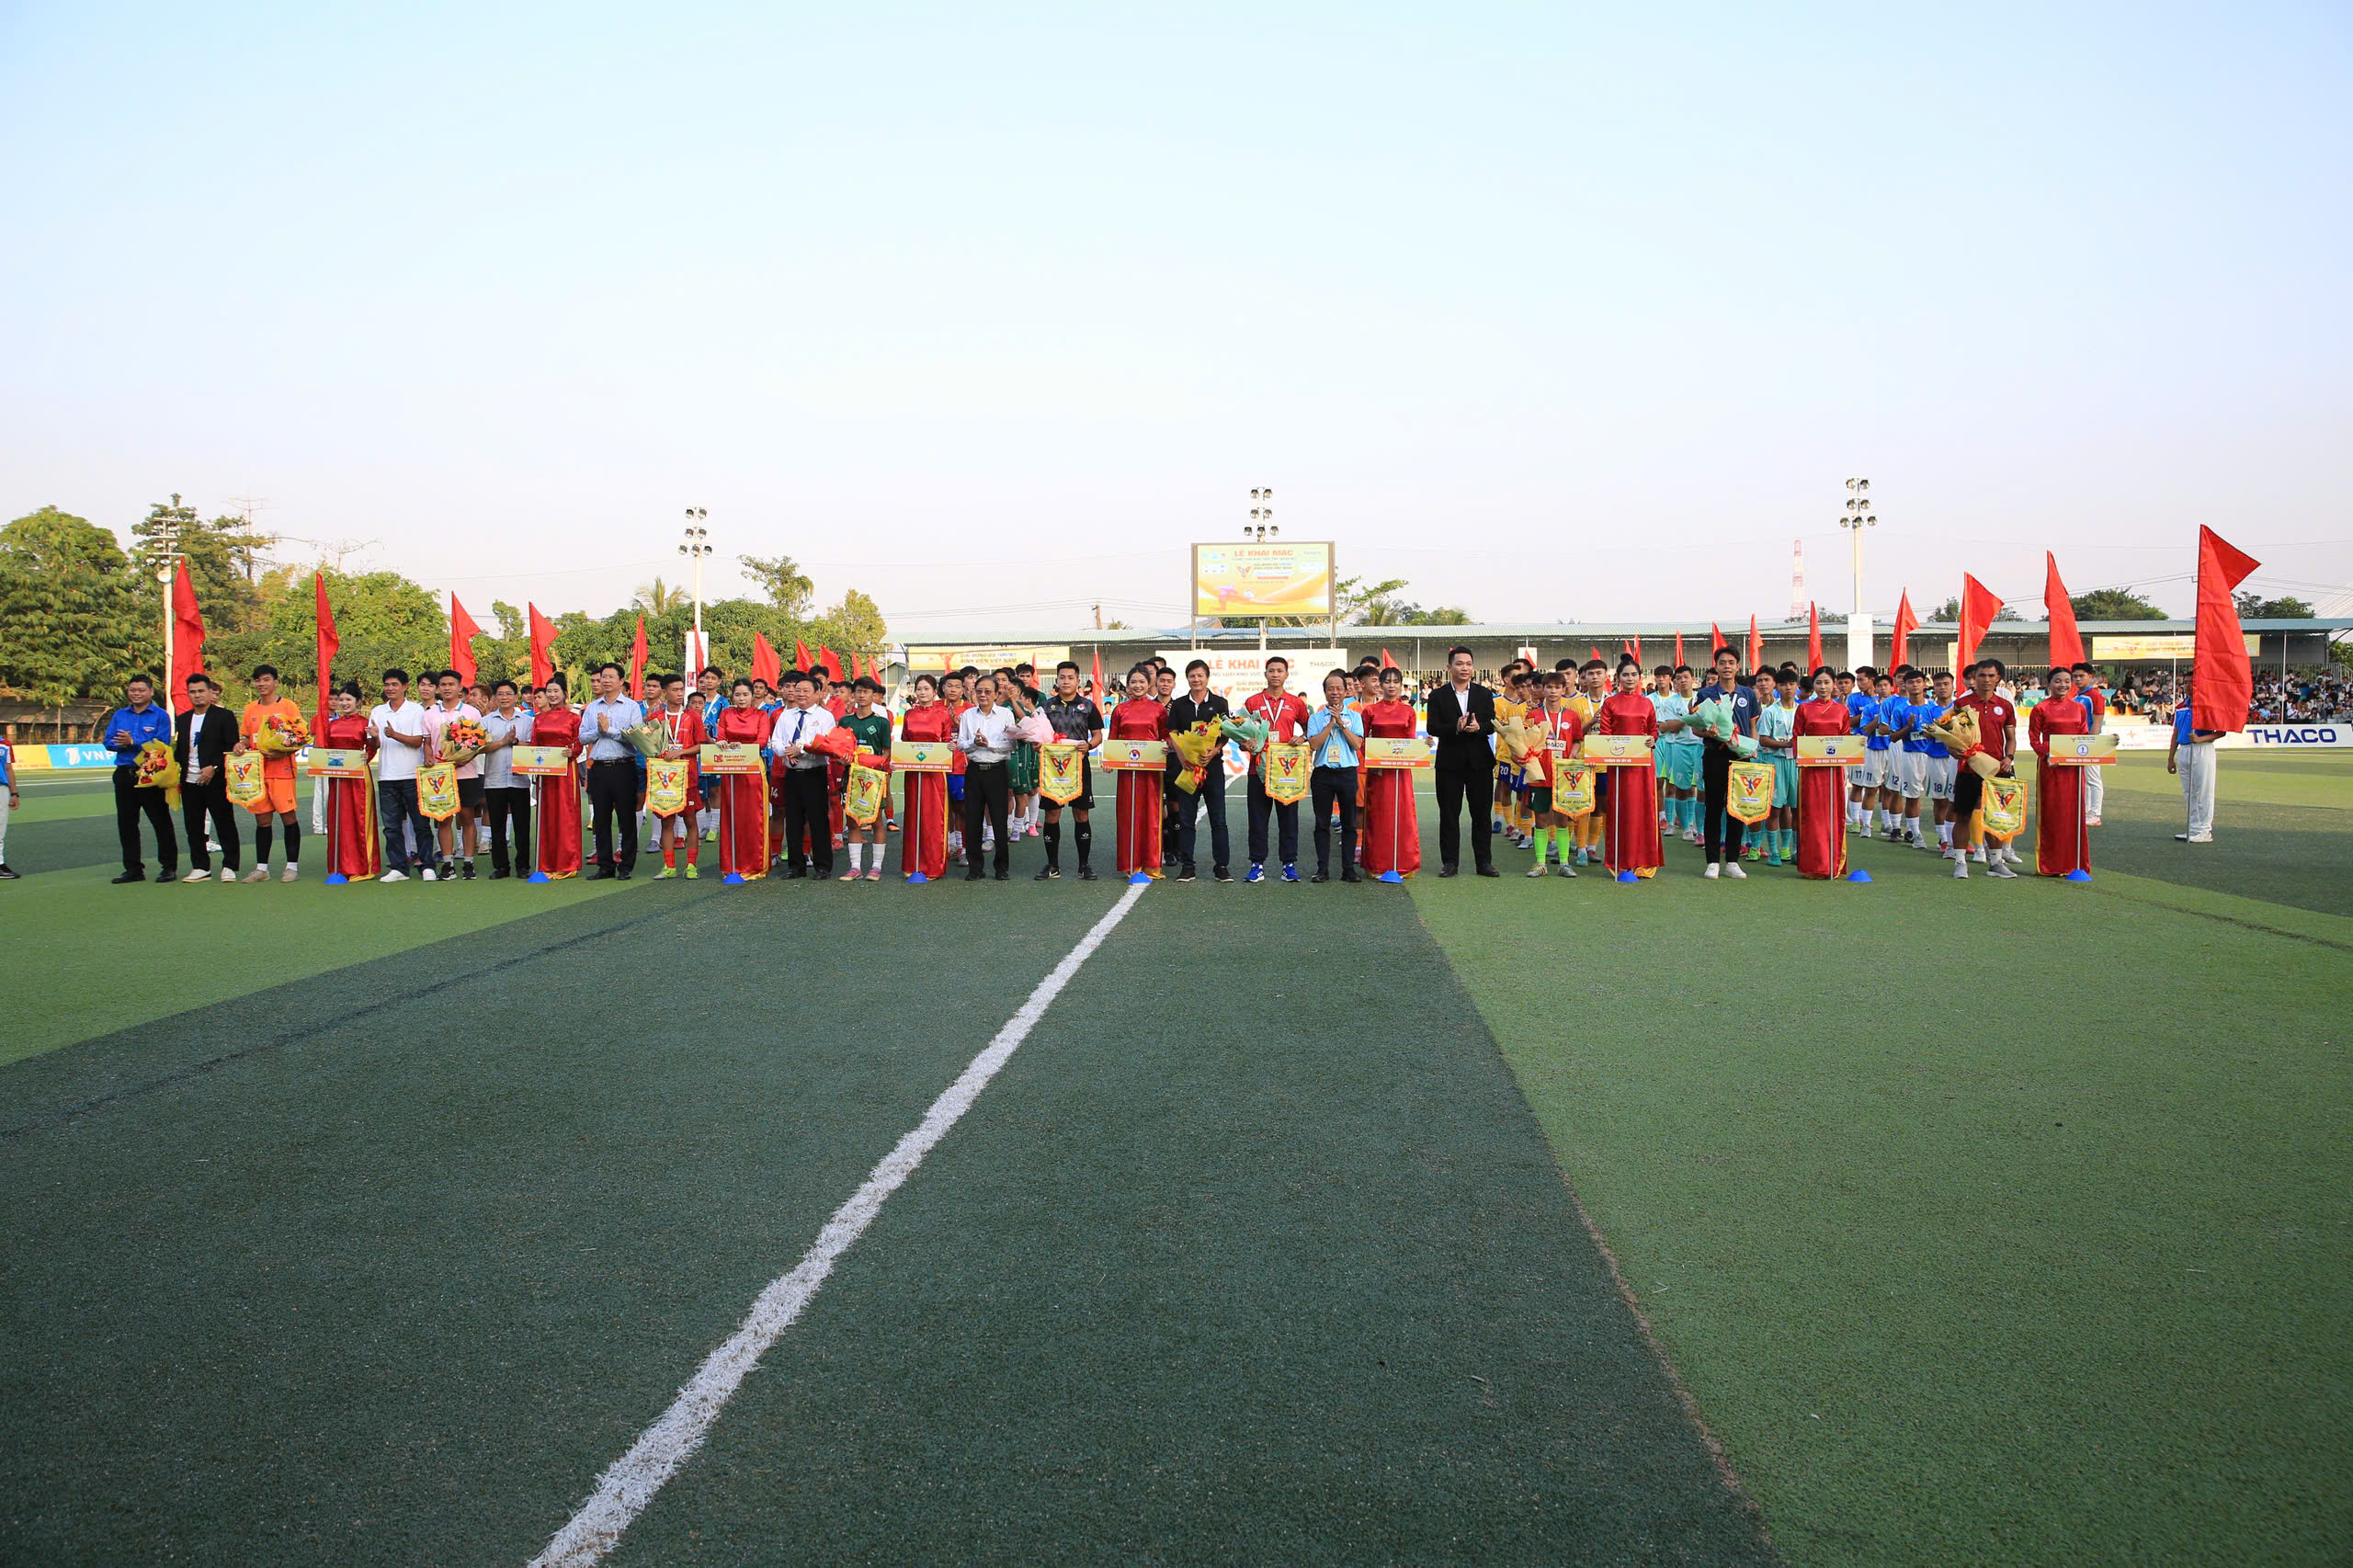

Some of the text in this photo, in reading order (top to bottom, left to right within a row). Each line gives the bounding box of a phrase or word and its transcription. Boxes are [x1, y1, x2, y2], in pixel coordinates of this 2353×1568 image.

[1228, 659, 1260, 669] KHAI
[2246, 729, 2337, 744] THACO
[82, 750, 116, 761] VNP
[1500, 766, 1509, 775] 20
[1856, 770, 1862, 779] 17
[1866, 772, 1872, 781] 11
[1892, 775, 1900, 785] 12
[1904, 782, 1908, 790] 2
[1934, 782, 1942, 792] 18
[771, 787, 779, 799] 14
